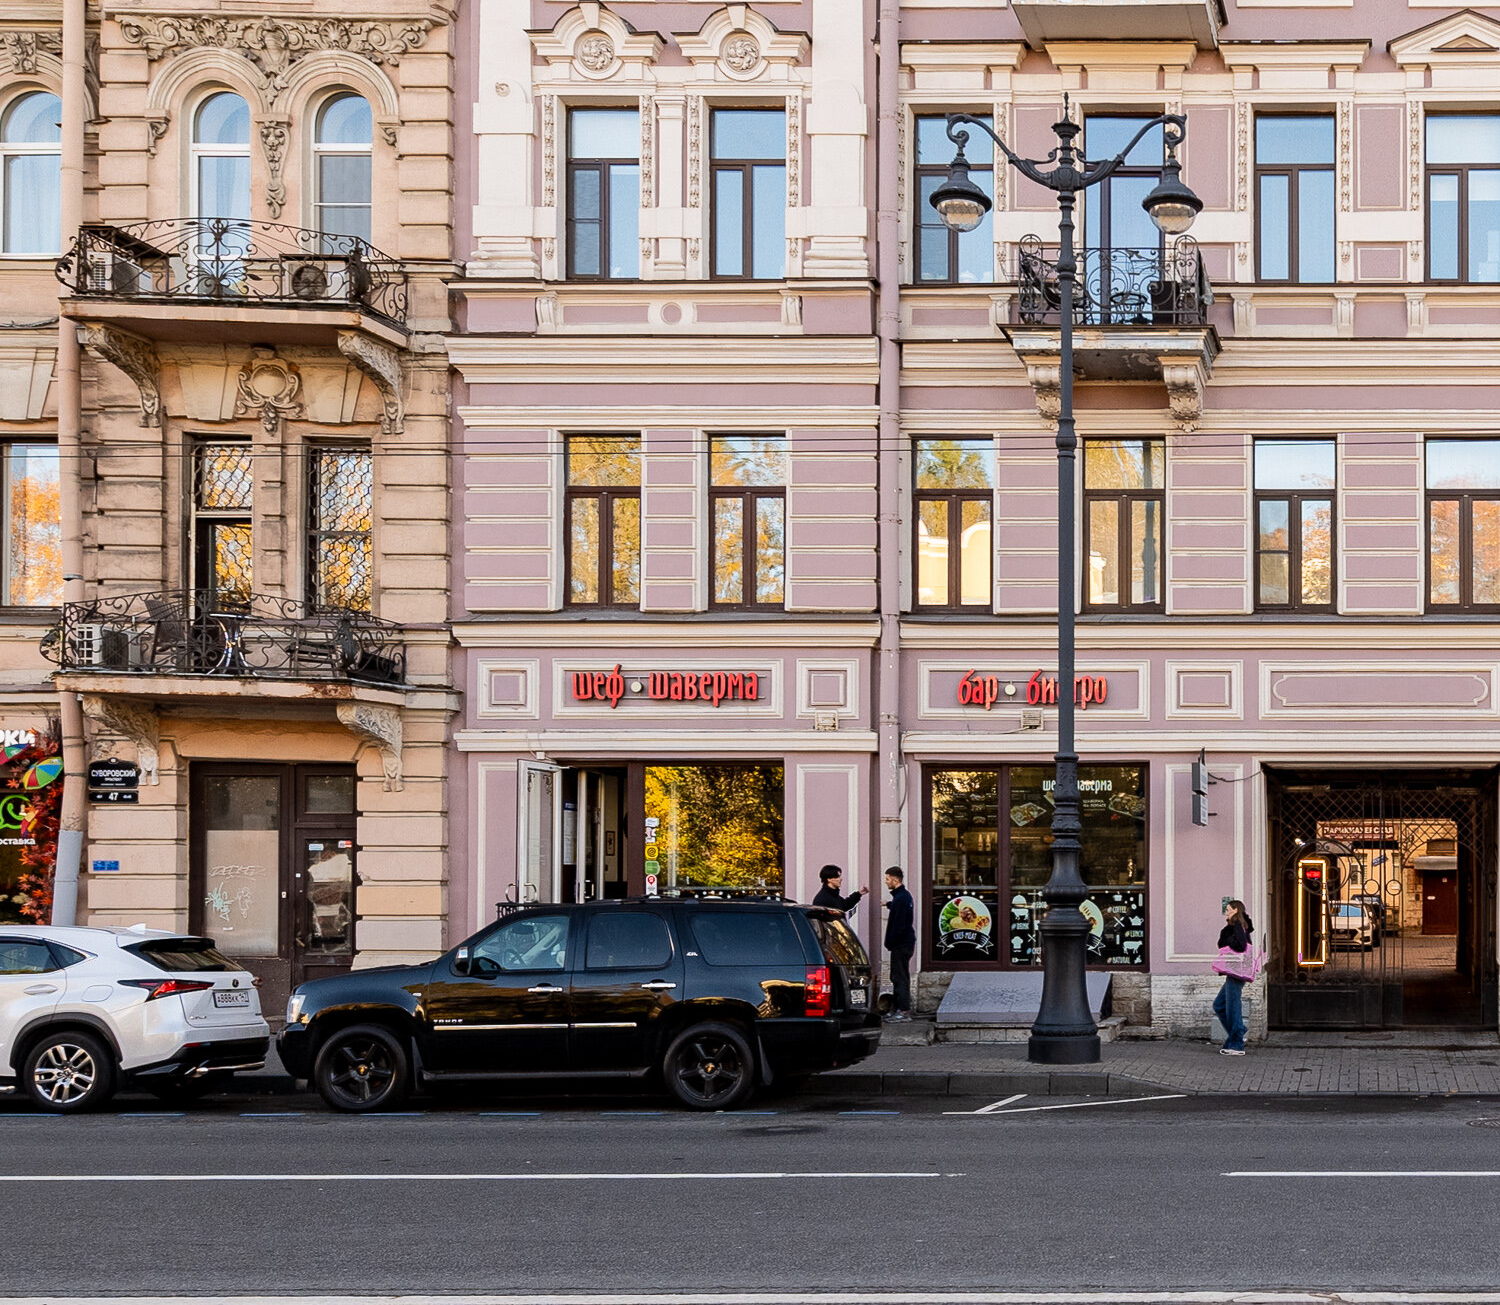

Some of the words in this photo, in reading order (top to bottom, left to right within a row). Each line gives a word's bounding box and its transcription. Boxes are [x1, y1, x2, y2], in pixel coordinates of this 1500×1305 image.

[572, 663, 624, 708] шеф
[649, 671, 758, 708] шаверма
[958, 668, 998, 710] бар
[1026, 668, 1108, 710] битро
[91, 768, 136, 777] СУВОРОВСКИЙ
[1042, 779, 1056, 791] ше
[108, 792, 118, 801] 47
